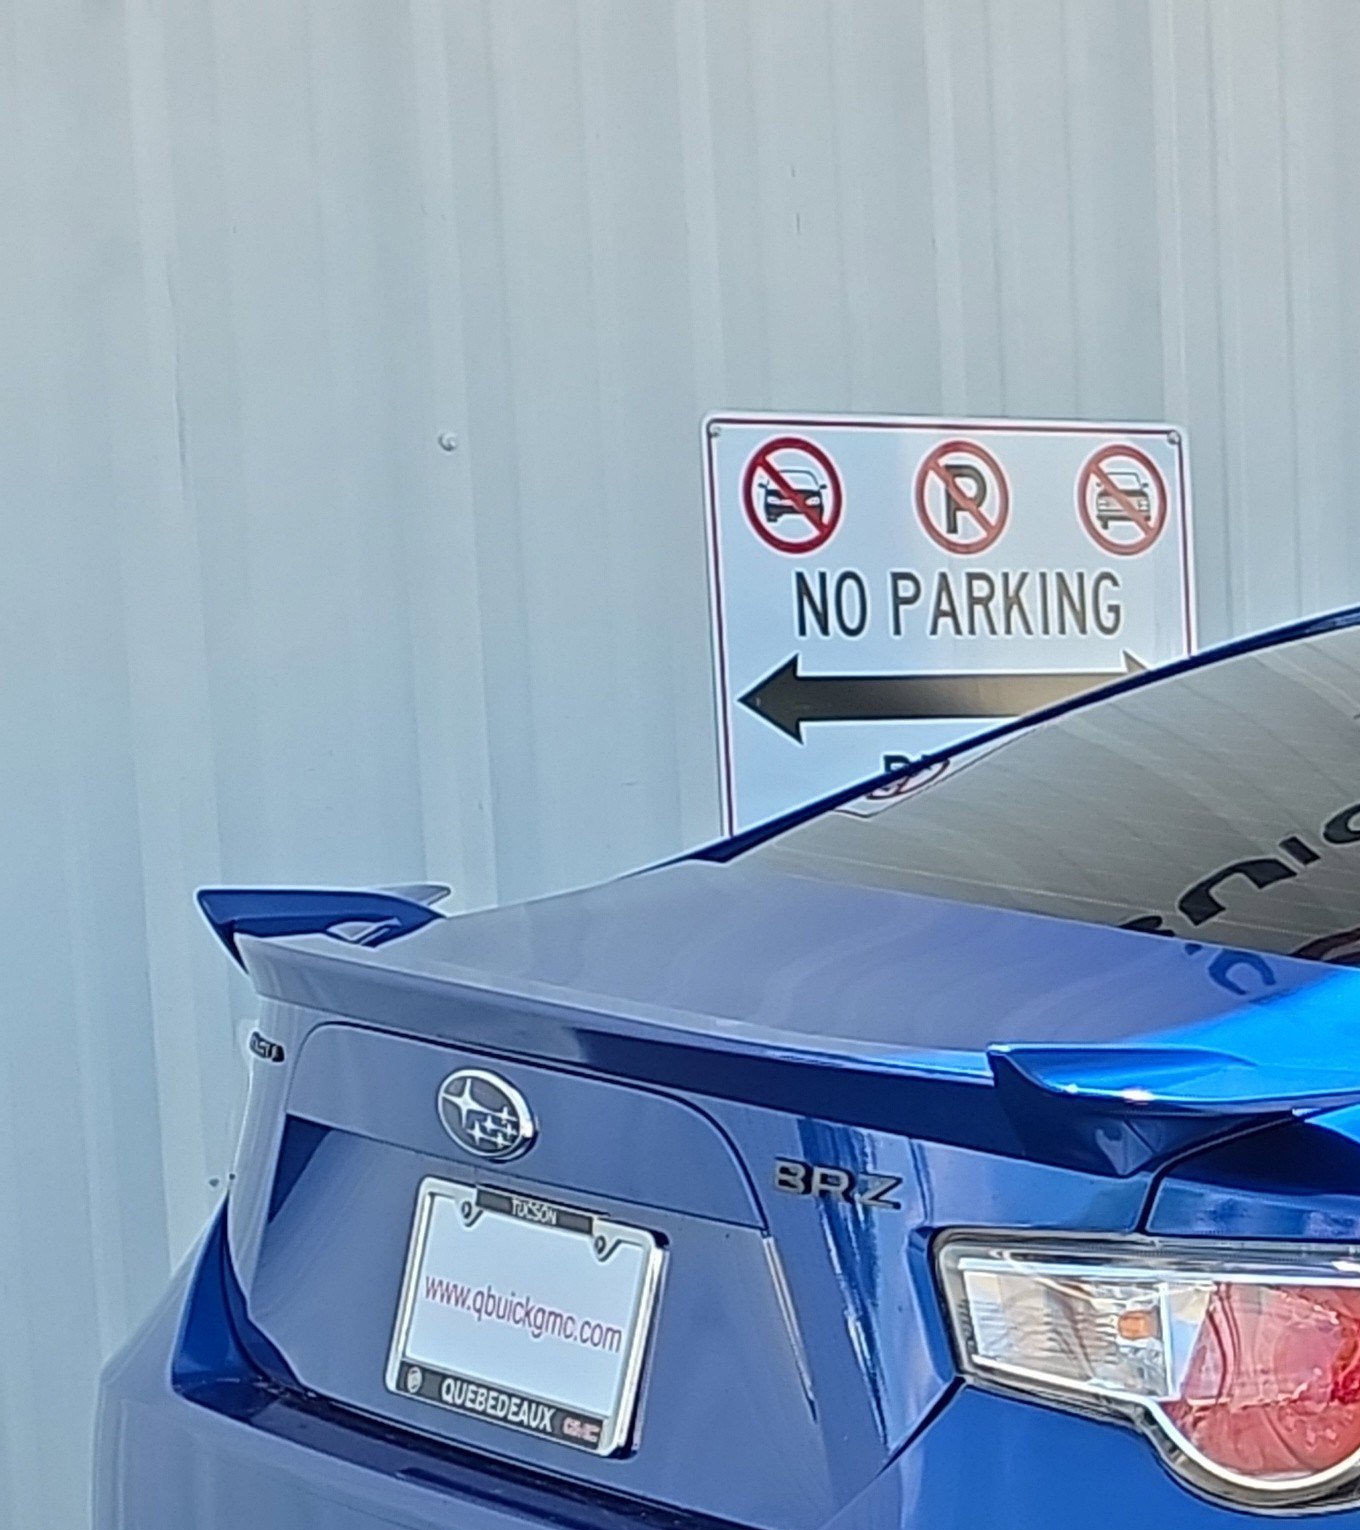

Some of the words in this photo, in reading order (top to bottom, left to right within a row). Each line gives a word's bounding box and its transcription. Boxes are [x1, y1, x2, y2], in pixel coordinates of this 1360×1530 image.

[794, 570, 868, 637] NO
[889, 570, 1123, 637] PARKING
[774, 1156, 903, 1210] BRZ
[511, 1199, 557, 1226] TUCSON
[424, 1275, 623, 1354] www.qbuickgmc.com
[440, 1378, 557, 1433] QUEBEDEAUX
